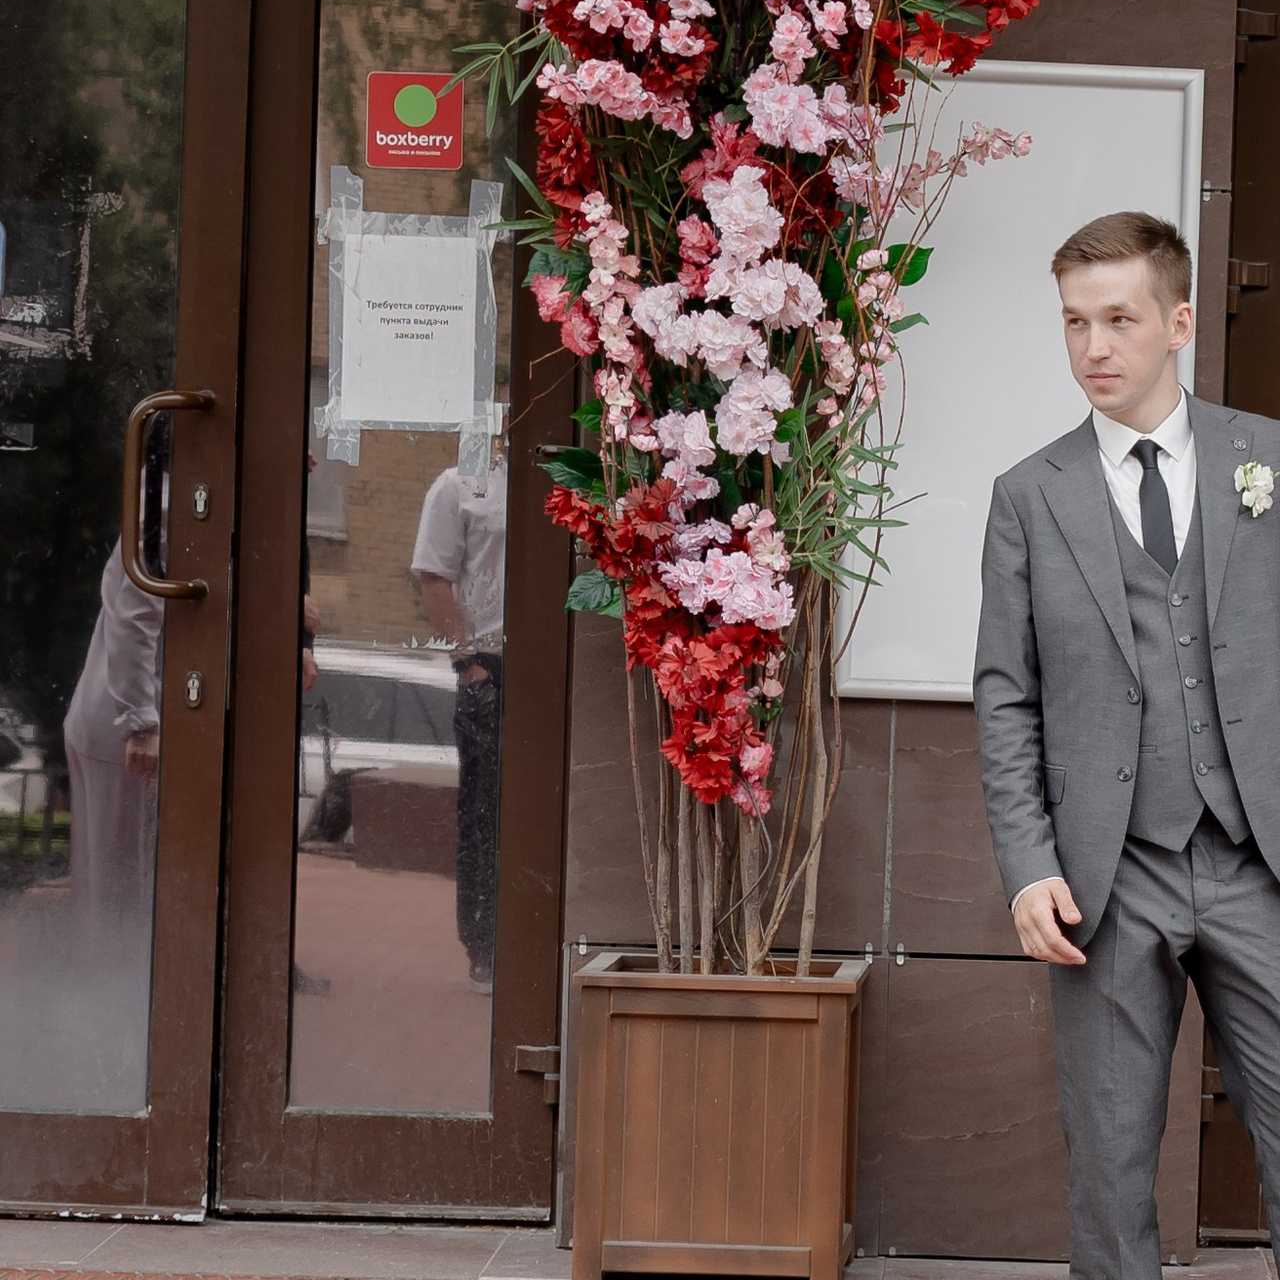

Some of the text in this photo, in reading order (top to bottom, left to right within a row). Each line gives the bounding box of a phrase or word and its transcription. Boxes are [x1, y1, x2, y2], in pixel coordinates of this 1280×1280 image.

[376, 130, 453, 150] boxberry
[366, 300, 464, 312] Требуется сотрудник
[380, 317, 449, 326] пункта выдачи
[394, 331, 434, 340] заказов!
